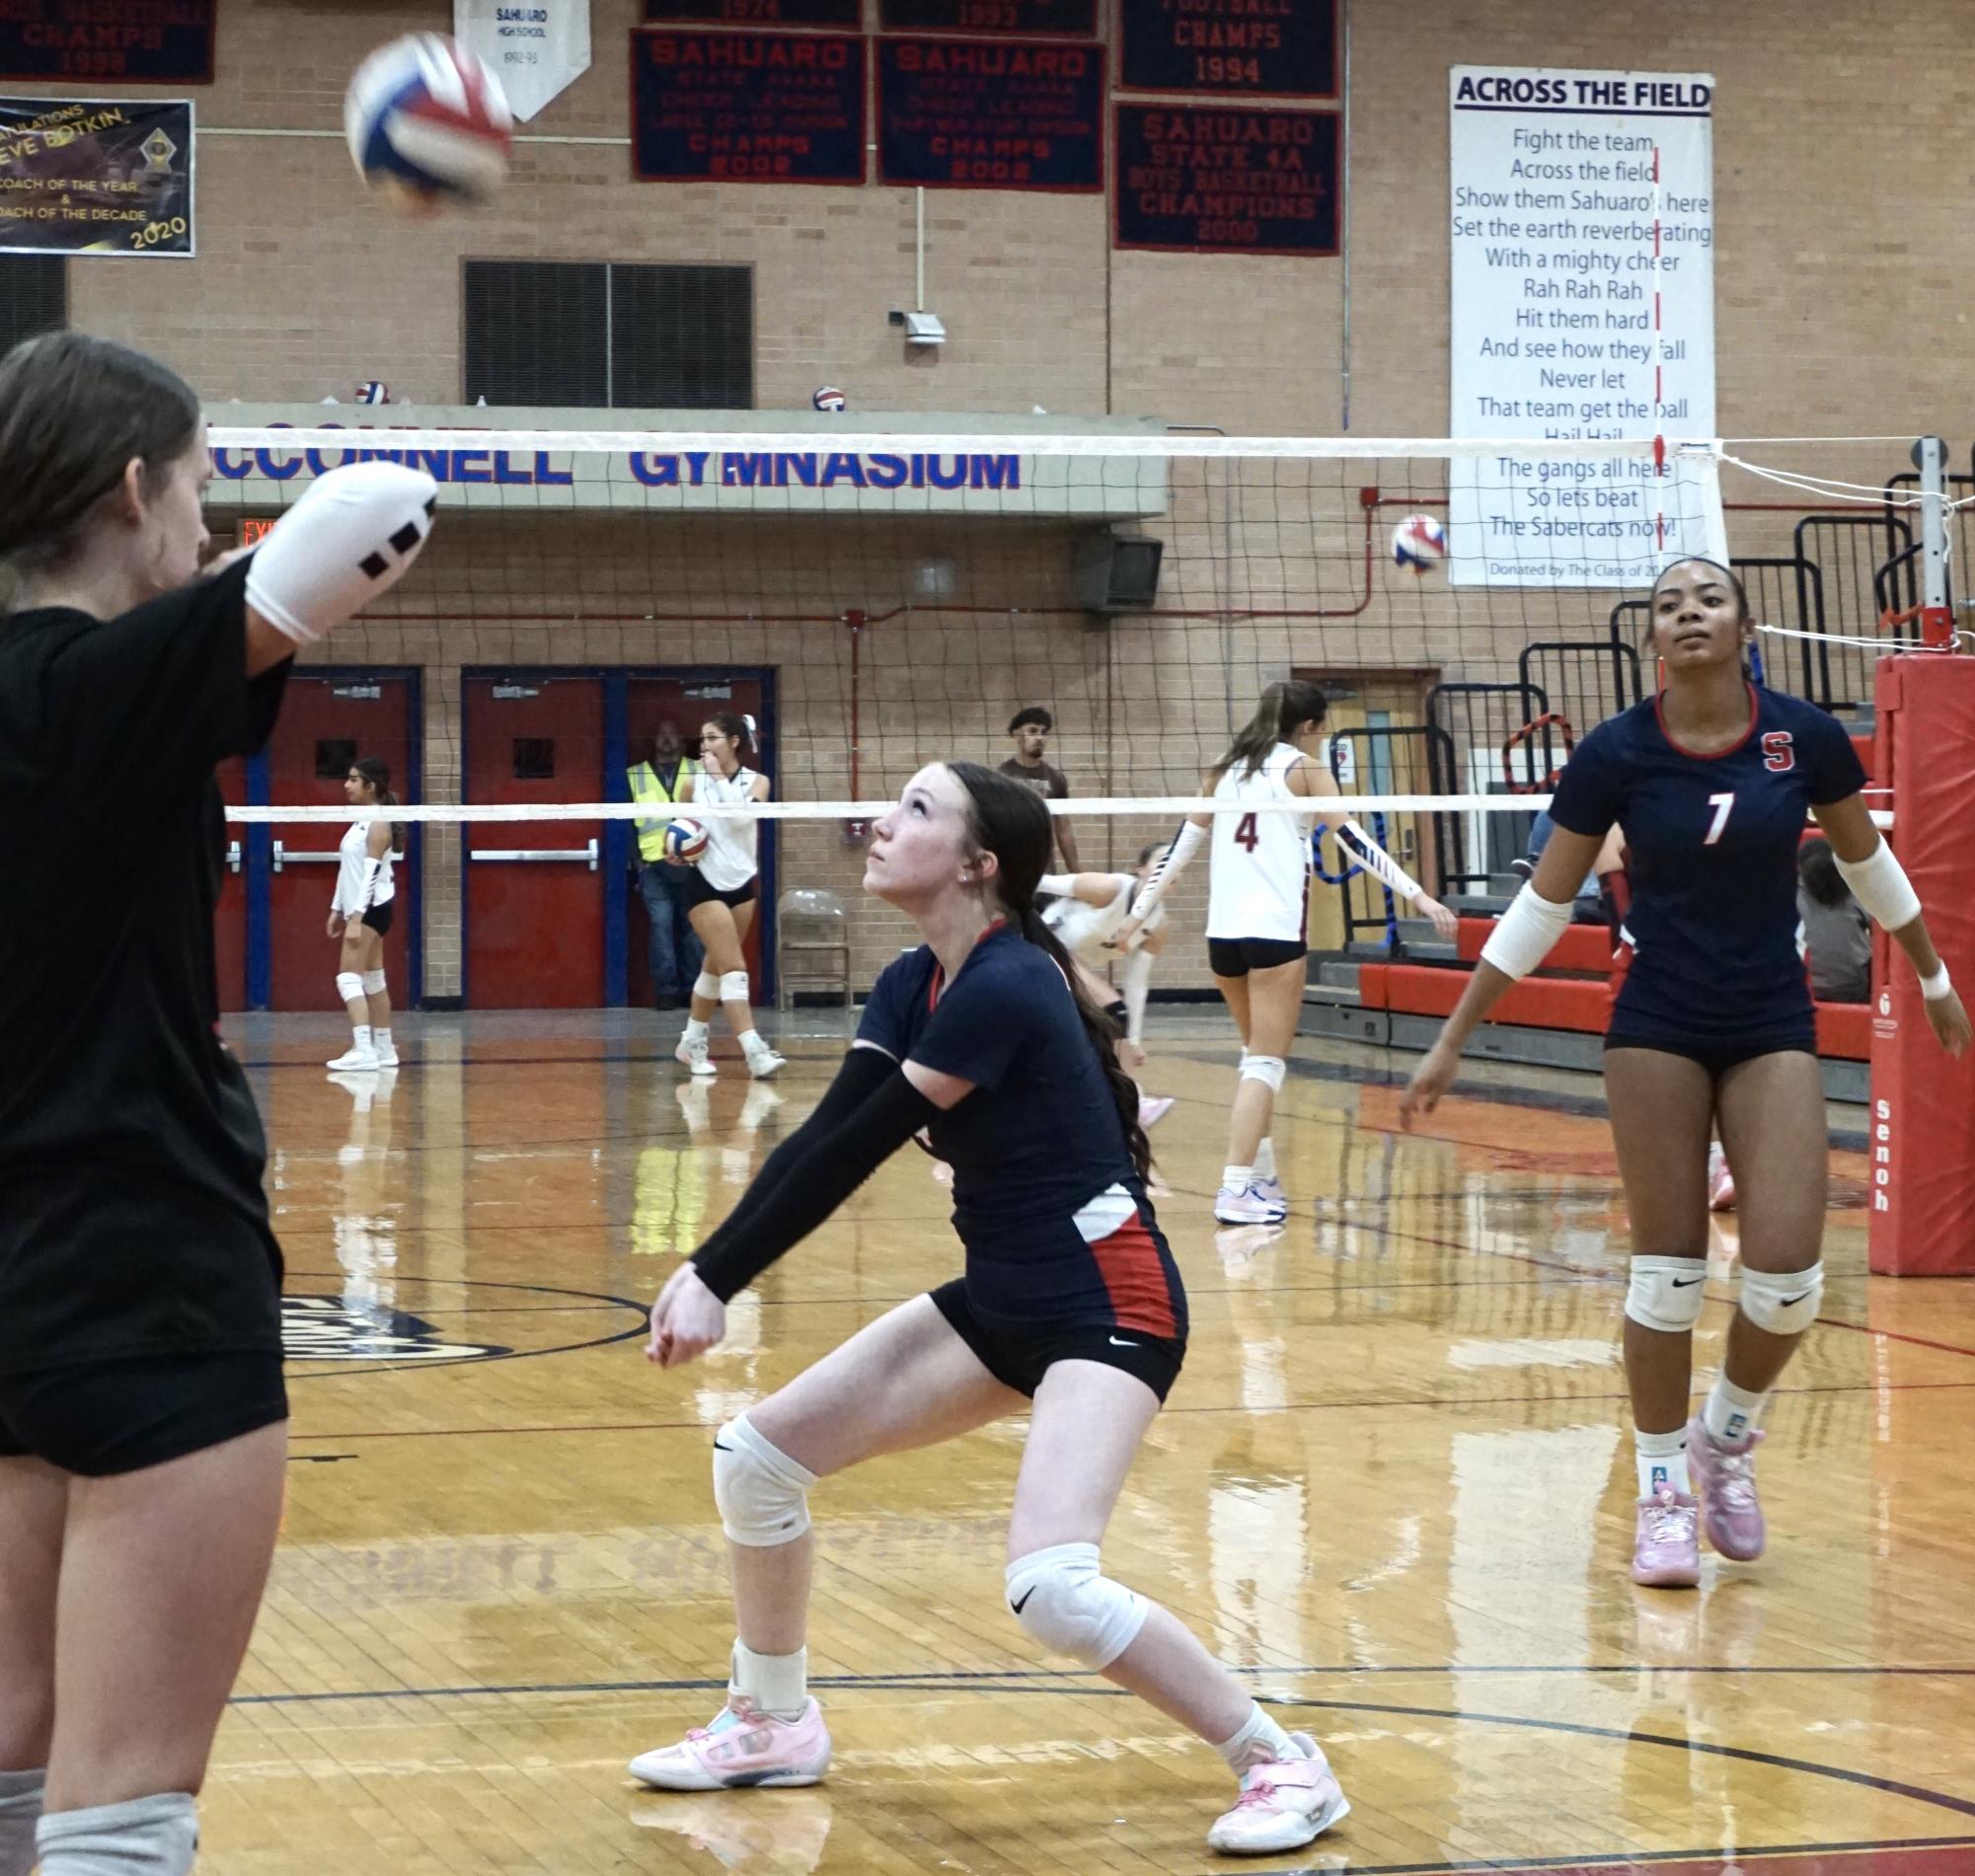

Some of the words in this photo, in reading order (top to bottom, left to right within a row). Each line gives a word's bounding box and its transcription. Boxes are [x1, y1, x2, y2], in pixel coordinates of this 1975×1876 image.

[24, 25, 163, 49] CHAMPS
[1174, 21, 1281, 48] CHAMPS
[651, 38, 847, 68] SAHUARO
[895, 45, 1086, 77] SAHUARO
[1196, 55, 1260, 83] 1994
[1457, 77, 1567, 104] ACROSS
[1573, 80, 1627, 105] THE
[1634, 82, 1710, 108] FIELD
[1143, 113, 1312, 145] SAHUARO
[1513, 128, 1562, 153] Fight
[1568, 129, 1599, 150] the
[1606, 133, 1654, 151] team
[688, 133, 810, 155] CHAMPS
[931, 137, 1050, 159] CHAMPS
[1150, 144, 1250, 168] STATE
[1194, 170, 1326, 194] BASKETBALL
[1510, 159, 1572, 181] Across
[1579, 161, 1609, 181] the
[1616, 161, 1657, 182] field
[47, 179, 66, 190] OF
[71, 180, 97, 191] THE
[102, 181, 138, 192] YEAR
[61, 193, 70, 205] &
[1139, 191, 1317, 219] CHAMPIONS
[1455, 188, 1508, 208] Show
[1514, 188, 1564, 209] them
[1571, 190, 1661, 211] Sahuaro'
[1667, 191, 1709, 213] here
[38, 207, 56, 219] OF
[62, 208, 87, 220] THE
[92, 209, 147, 221] DECADE
[130, 216, 187, 249] 2020
[1453, 217, 1482, 237] Set
[1488, 217, 1520, 238] the
[1526, 218, 1577, 240] earth
[1485, 248, 1530, 268] With
[1537, 254, 1547, 268] a
[1553, 249, 1621, 274] mighty
[1627, 251, 1680, 271] cheer
[1524, 278, 1558, 298] Rah
[1565, 279, 1601, 299] Rah
[1607, 280, 1642, 300] Rah
[1516, 308, 1543, 329] Hit
[1550, 308, 1599, 330] them
[1606, 309, 1648, 331] hard
[1480, 338, 1518, 357] And
[1525, 342, 1557, 358] see
[1562, 338, 1602, 358] how
[1610, 338, 1651, 364] they
[1540, 368, 1596, 389] Never
[1602, 369, 1626, 390] let
[1478, 397, 1520, 417] That
[1527, 401, 1574, 417] team
[1580, 402, 1611, 422] get
[1618, 399, 1648, 418] the
[1654, 399, 1688, 418] ball
[630, 430, 1021, 489] GYMNASIUM
[1497, 457, 1531, 477] The
[1539, 461, 1595, 482] gangs
[1602, 458, 1622, 478] all
[1629, 458, 1671, 479] here
[1527, 488, 1551, 507] So
[1557, 488, 1590, 507] lets
[1595, 488, 1638, 508] beat
[245, 521, 279, 548] EXI
[1489, 516, 1526, 536] The
[1531, 516, 1624, 537] Sabercats
[1630, 518, 1676, 537] now!
[1490, 563, 1546, 577] Donated
[1550, 563, 1564, 579] by
[1568, 563, 1591, 576] The
[1594, 563, 1626, 577] Class
[1629, 563, 1641, 577] of
[1761, 731, 1795, 772] S
[1234, 811, 1258, 854] 4
